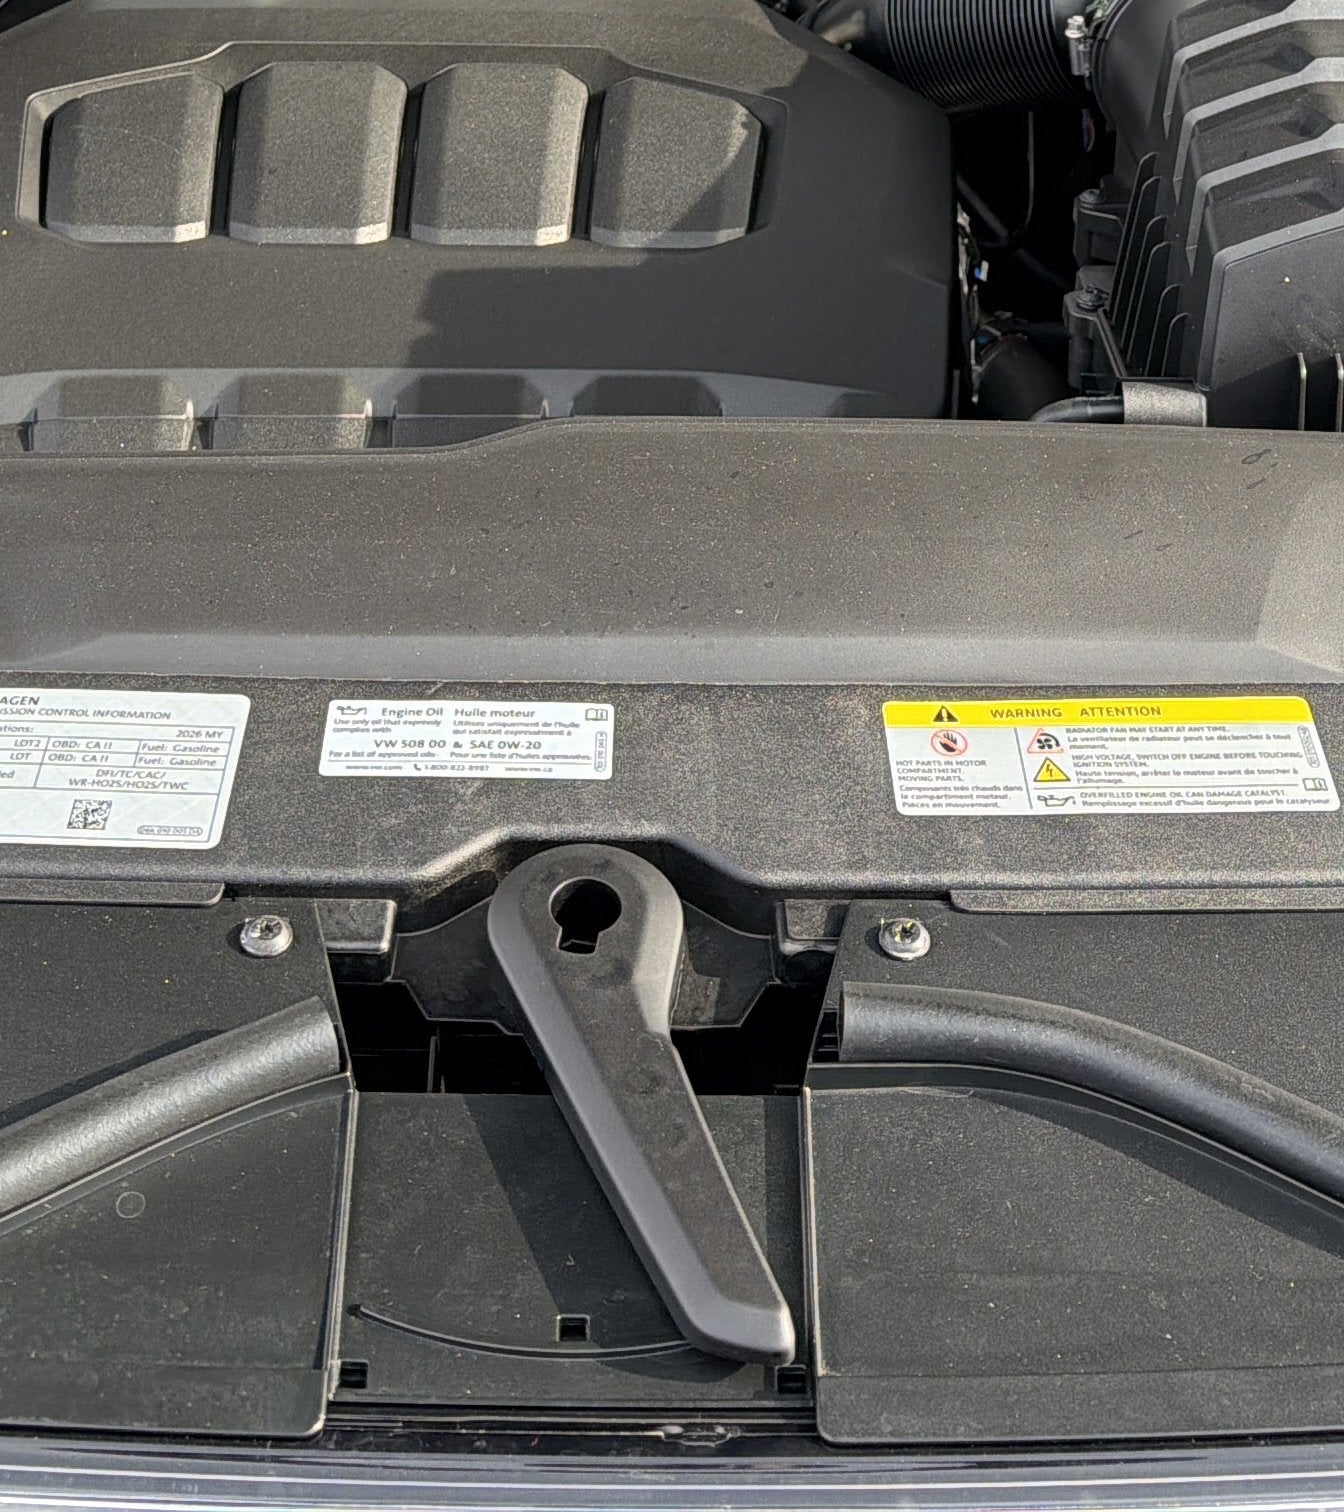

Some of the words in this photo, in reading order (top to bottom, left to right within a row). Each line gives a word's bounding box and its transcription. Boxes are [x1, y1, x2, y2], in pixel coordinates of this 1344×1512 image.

[37, 707, 90, 717] CONTROL
[92, 709, 172, 720] INFORMATION
[381, 707, 423, 719] Engine
[425, 707, 444, 717] Oil
[454, 708, 487, 718] Huile
[489, 709, 535, 718] moteur
[990, 707, 1063, 719] WARNING
[1080, 706, 1162, 717] ATTENTION
[204, 730, 224, 739] MY
[85, 741, 100, 749] CA
[141, 743, 168, 752] Fuel:
[173, 744, 220, 754] Gasoline
[374, 739, 398, 748] VW
[401, 739, 425, 748] 508
[428, 739, 447, 748] 00
[452, 741, 463, 749] &
[469, 740, 494, 750] SAE
[497, 740, 542, 750] 0W-20
[81, 754, 97, 763] CA
[138, 756, 165, 765] Fuel:
[169, 757, 217, 767] Gasoline
